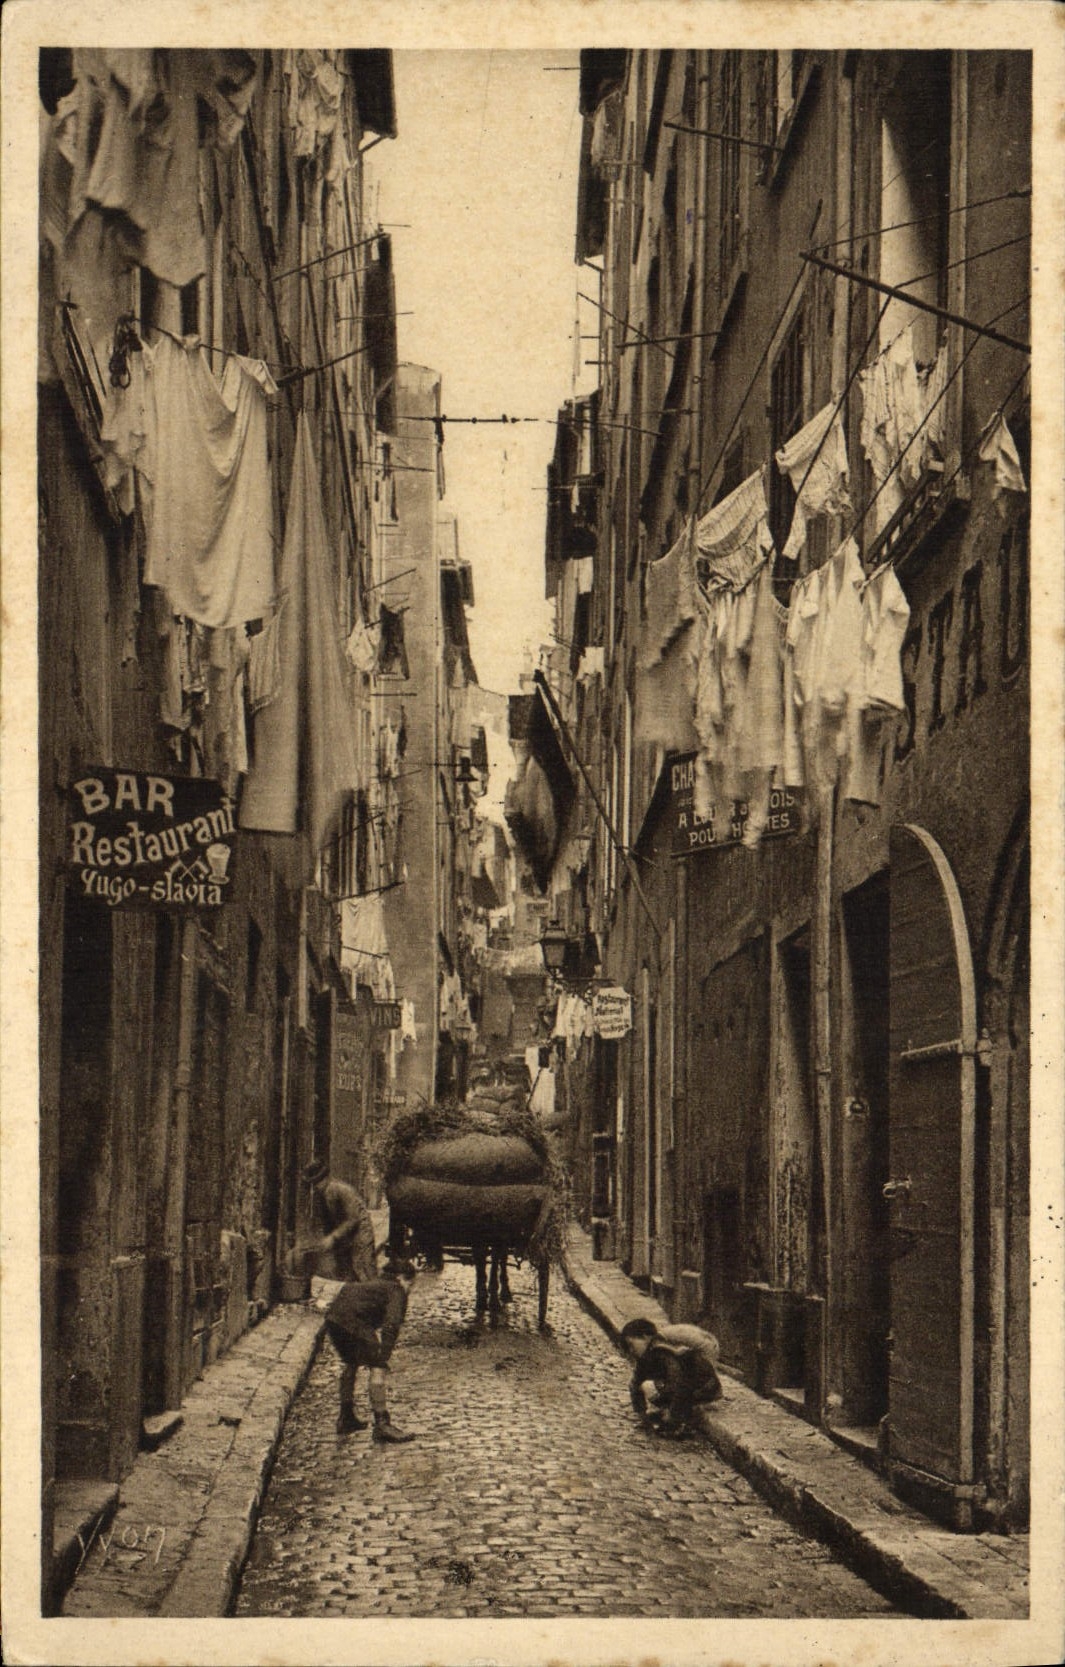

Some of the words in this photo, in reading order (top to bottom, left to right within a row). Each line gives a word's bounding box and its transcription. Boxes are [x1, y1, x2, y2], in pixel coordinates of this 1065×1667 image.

[73, 774, 174, 817] BAR
[71, 797, 237, 867] Restaurant
[678, 812, 688, 829] A
[689, 828, 717, 847] POU
